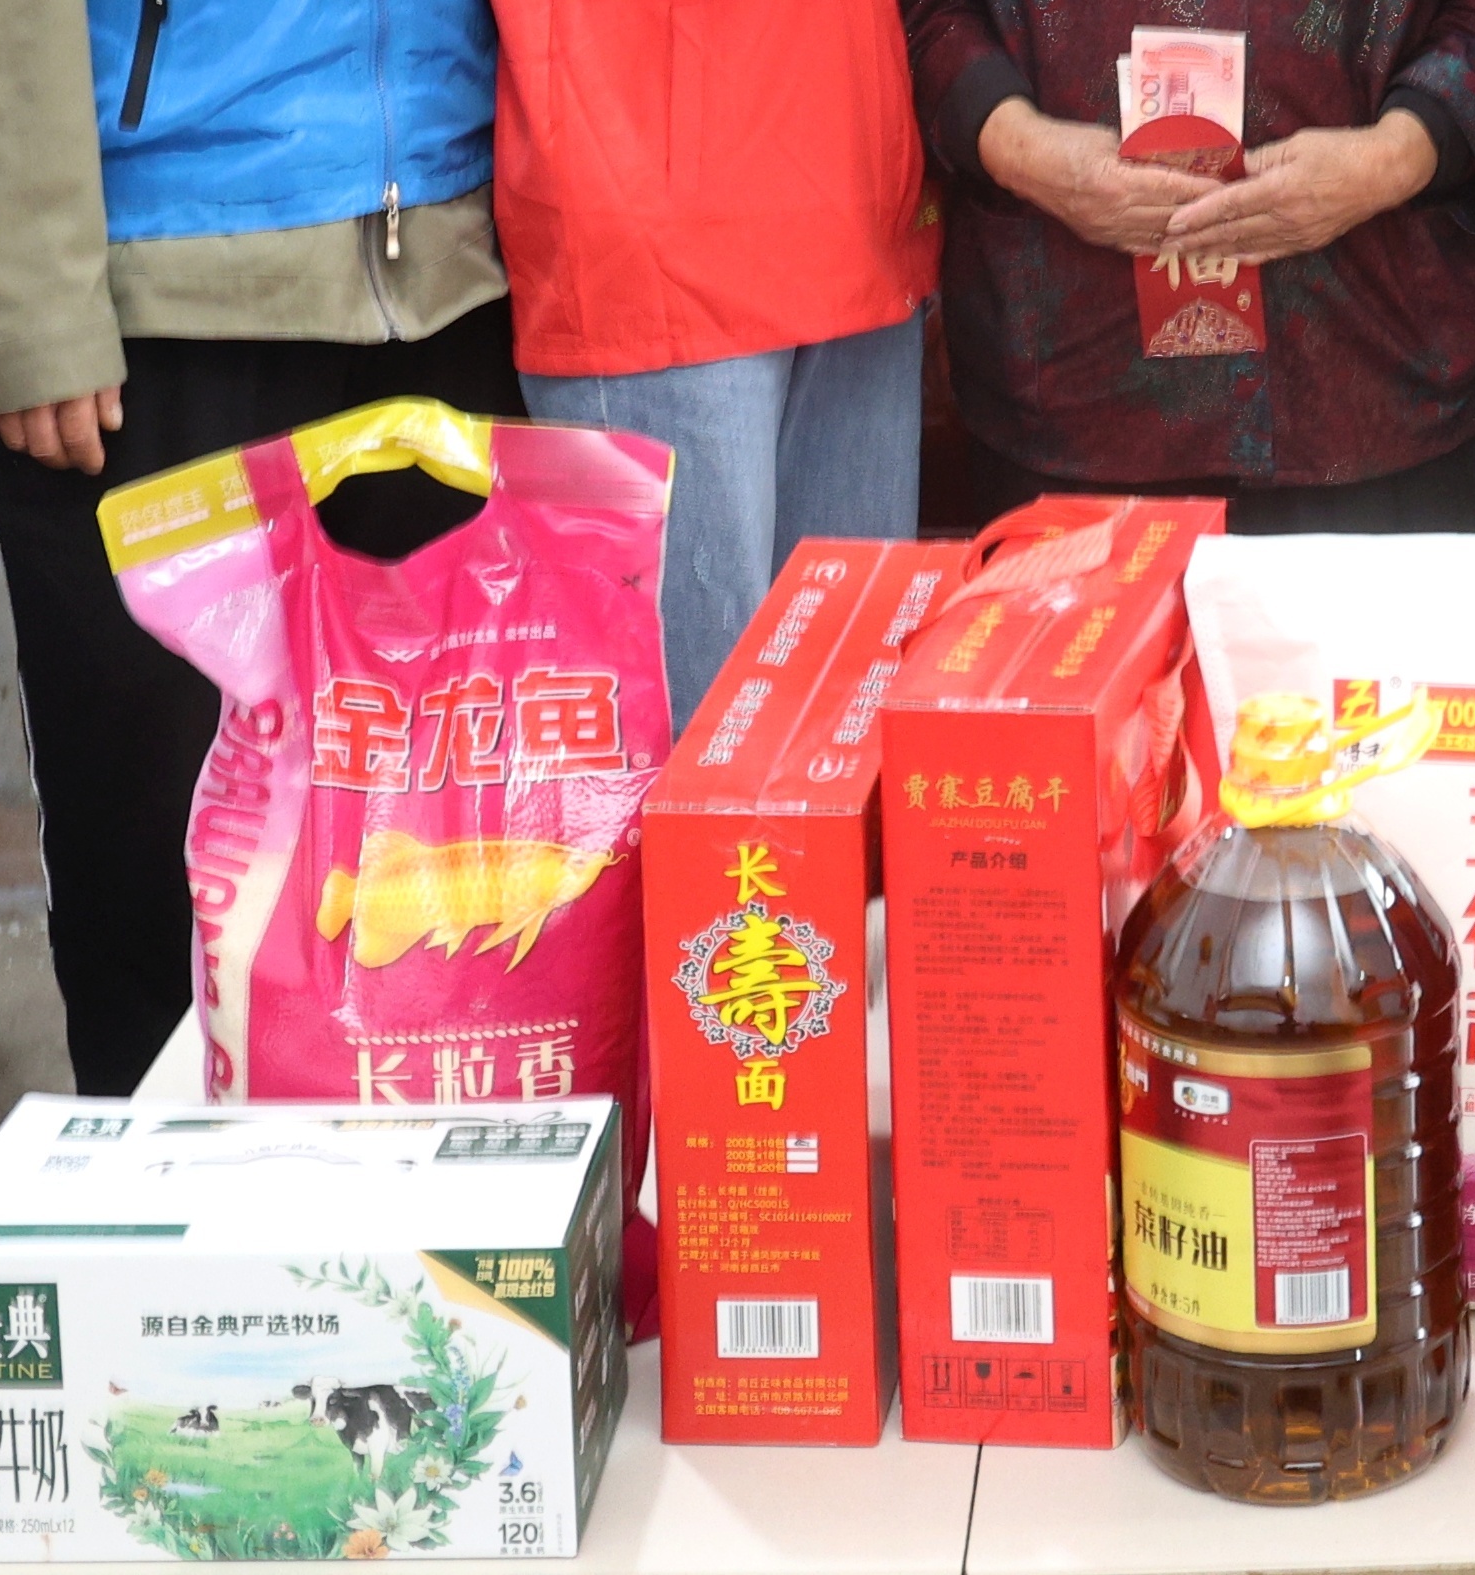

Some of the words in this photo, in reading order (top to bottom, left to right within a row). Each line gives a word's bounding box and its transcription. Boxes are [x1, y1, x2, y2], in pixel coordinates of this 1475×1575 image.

[313, 667, 629, 792] 金龙鱼
[903, 773, 1070, 814] 贾寨豆腐干
[1135, 1200, 1228, 1272] 菜籽油
[498, 1257, 556, 1281] 100%
[140, 1313, 341, 1338] 源自金典严选牧场
[498, 1481, 537, 1504] 3.6
[498, 1522, 538, 1545] 120
